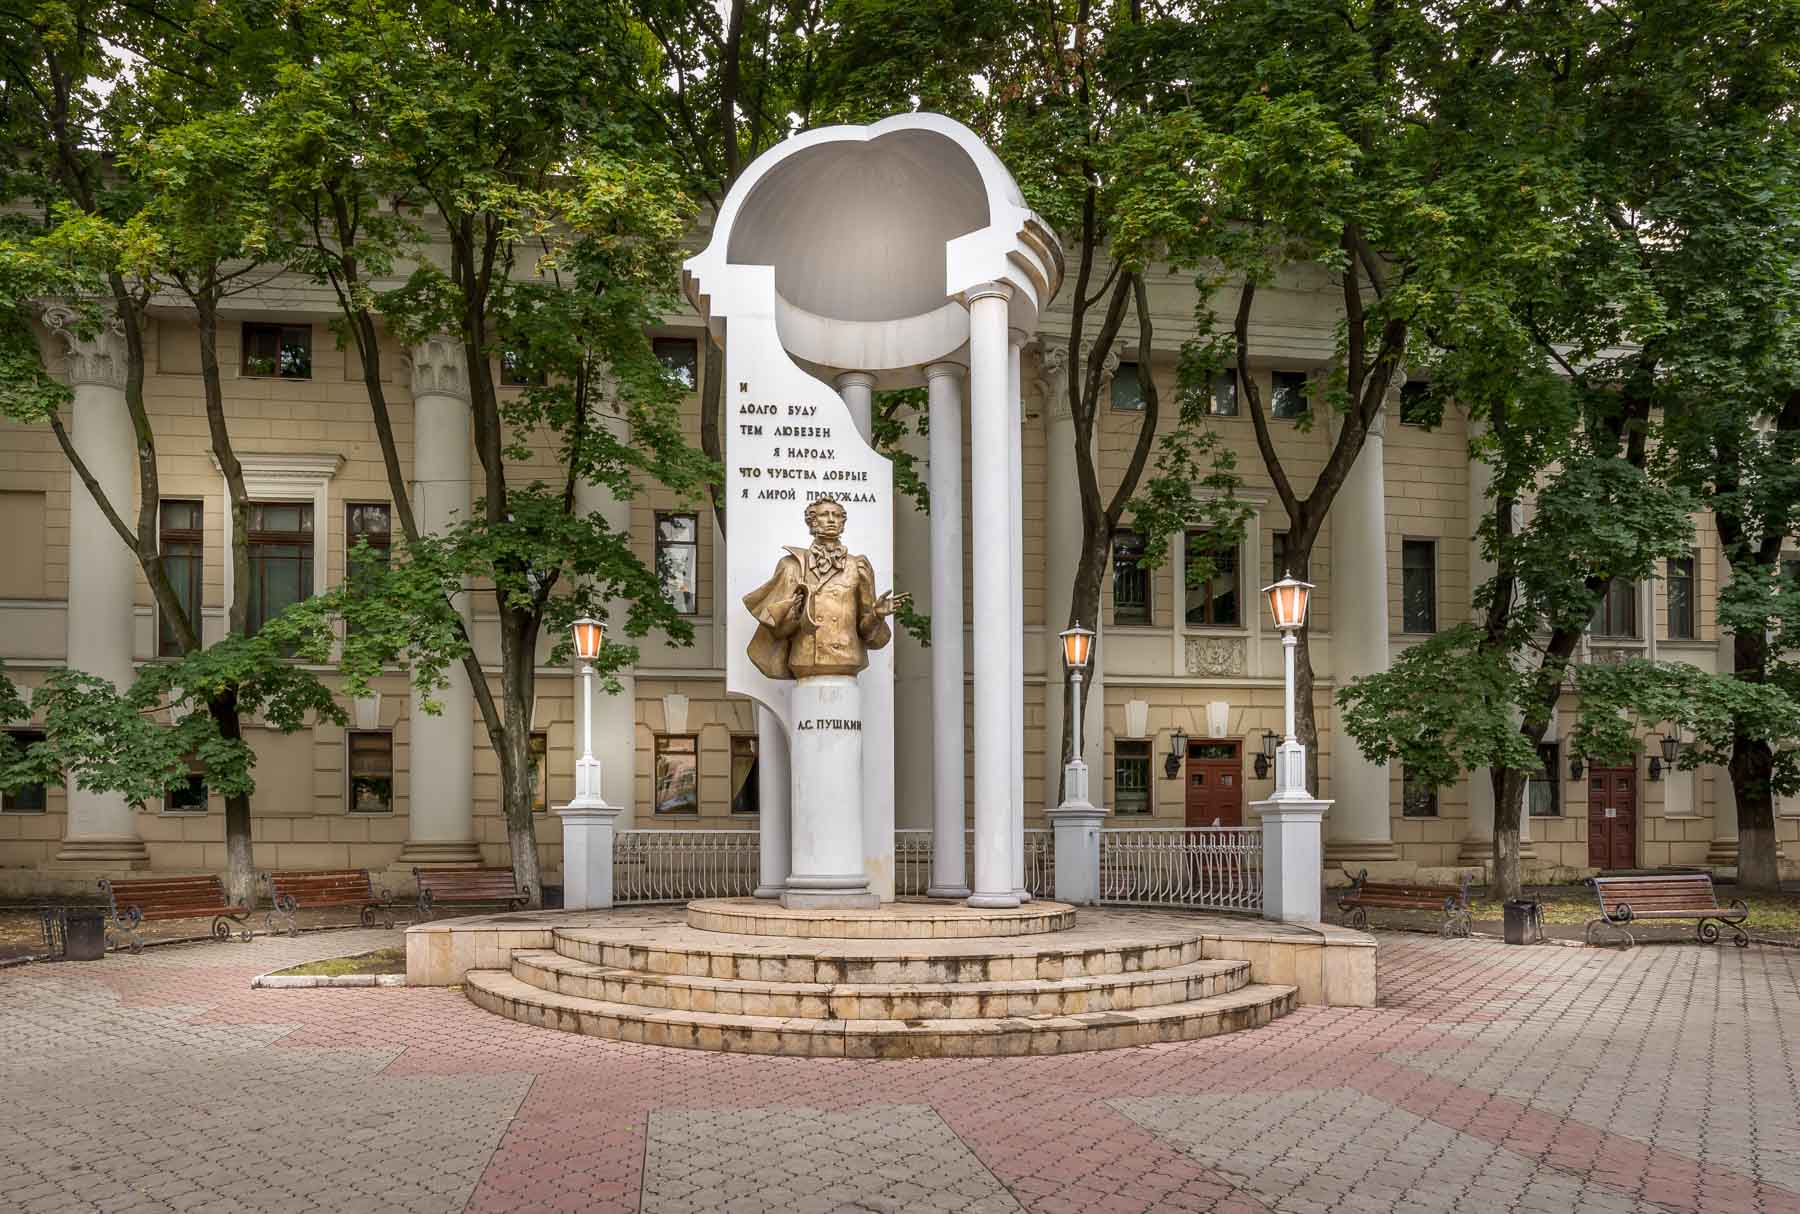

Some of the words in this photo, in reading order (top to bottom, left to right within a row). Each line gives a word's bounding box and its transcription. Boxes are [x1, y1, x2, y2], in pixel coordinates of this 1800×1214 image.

[739, 382, 748, 393] И
[739, 403, 778, 416] ДОЛГО
[788, 405, 817, 417] БУДУ
[739, 424, 763, 436] ТЕМ
[773, 425, 831, 438] ЛЮБЕЗЕН
[773, 447, 780, 457] Я
[738, 467, 762, 478] ЧТО
[767, 468, 817, 480] ЧУВСТВА
[822, 470, 868, 481] ДОБРЫЕ
[741, 488, 749, 499] Я
[757, 487, 796, 501] ЛИРОЙ
[816, 719, 862, 732] ПУШКИН
